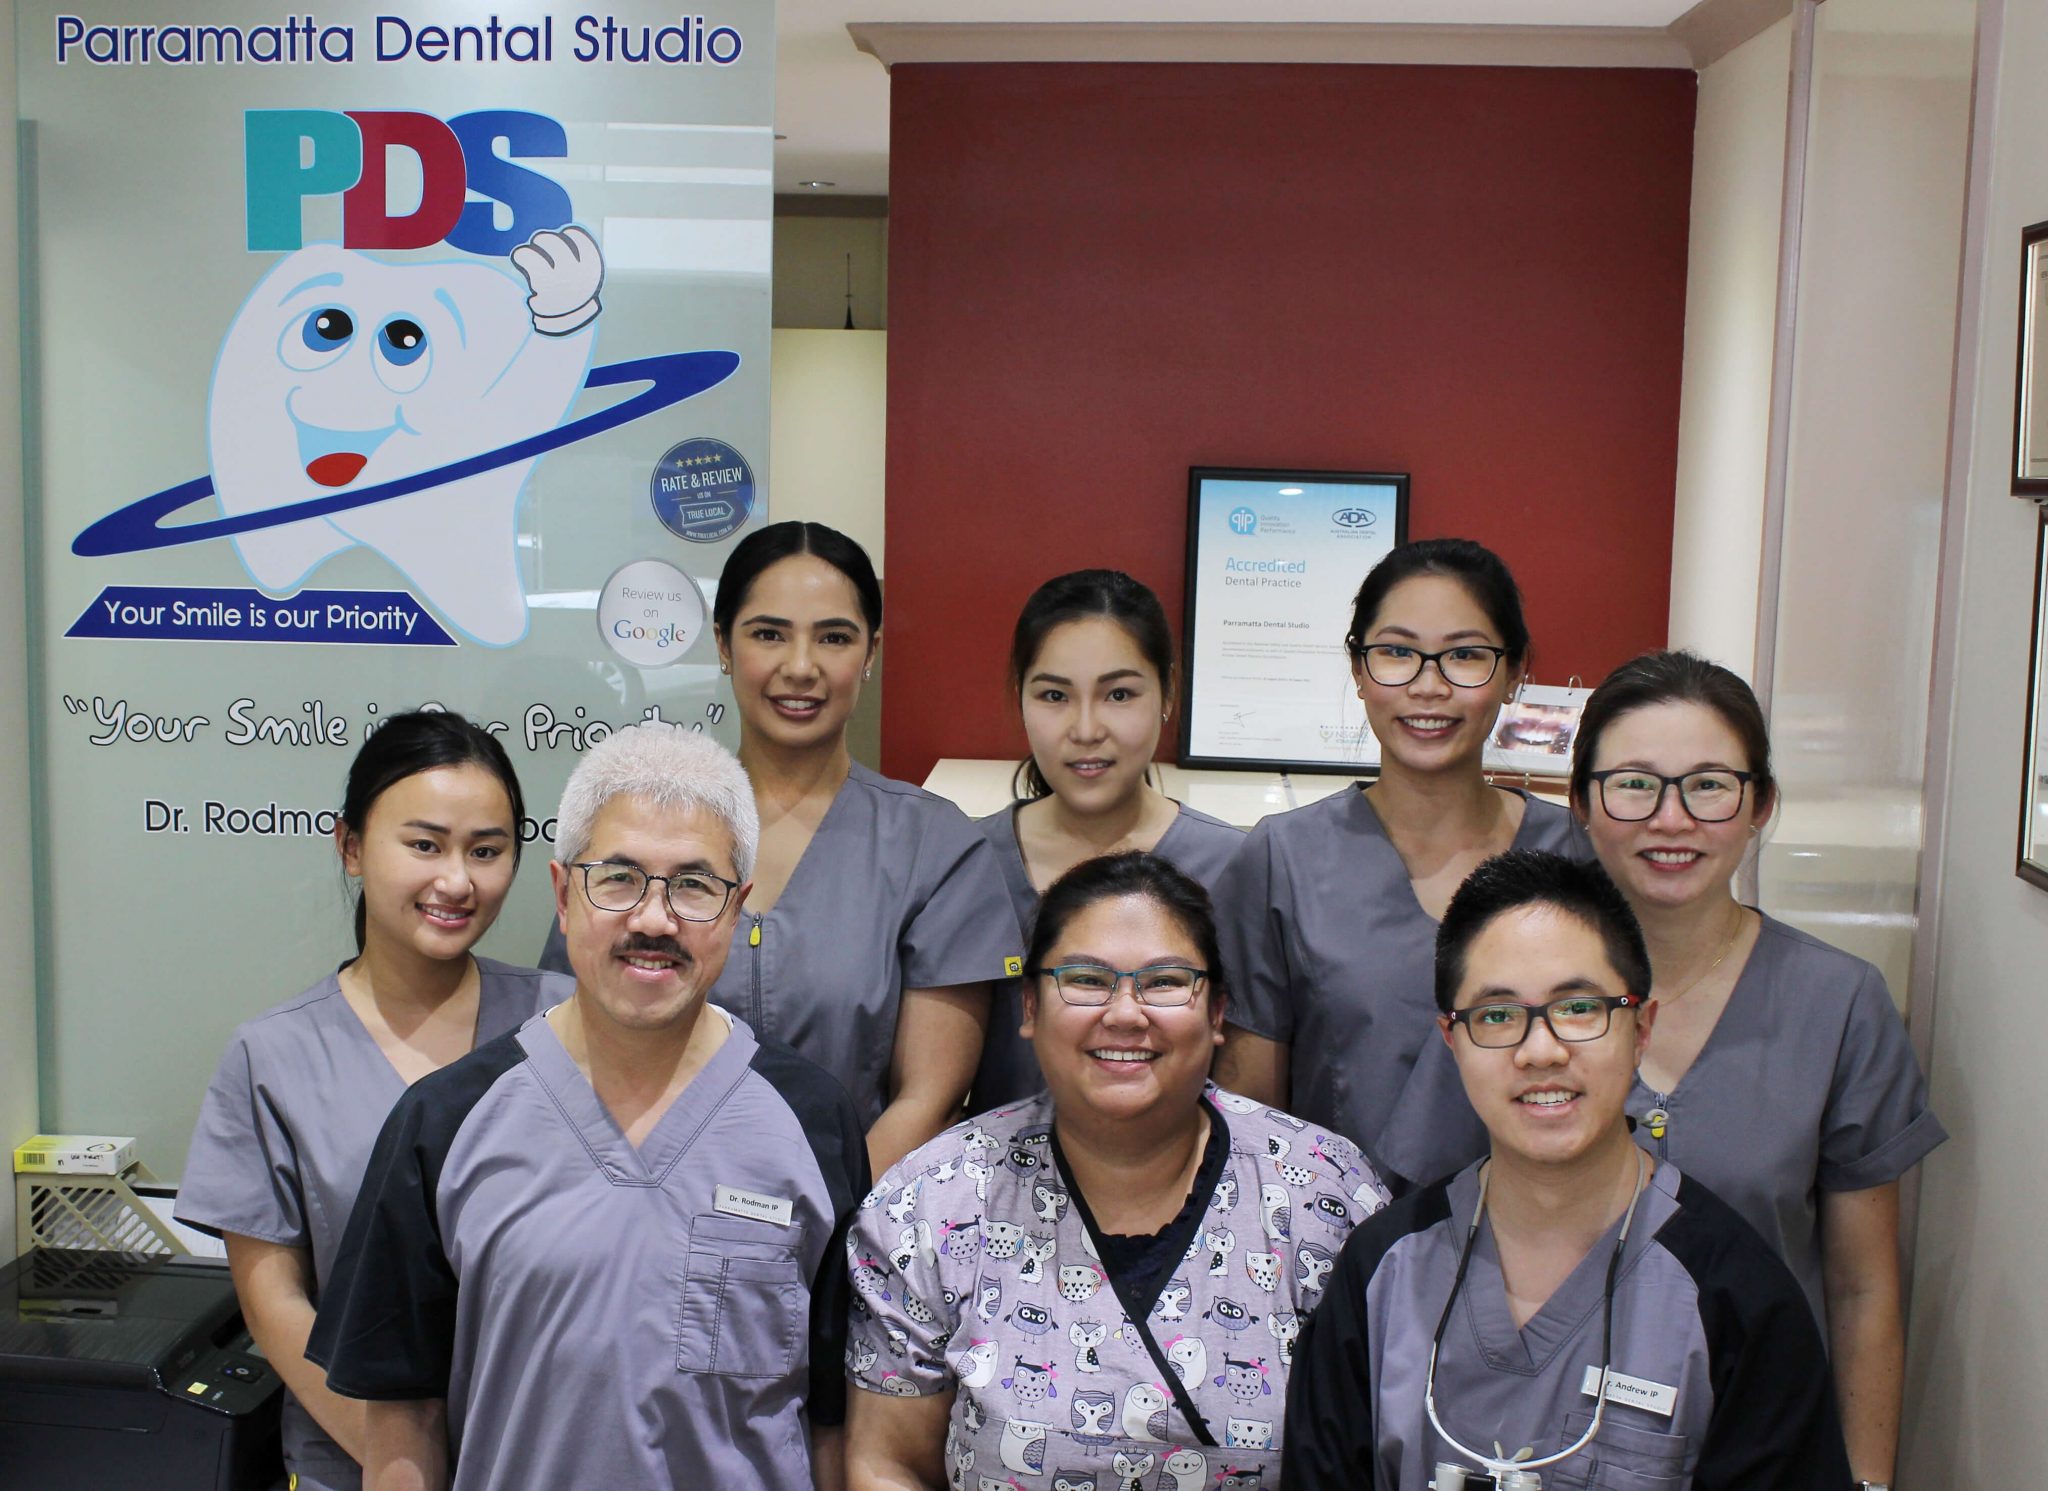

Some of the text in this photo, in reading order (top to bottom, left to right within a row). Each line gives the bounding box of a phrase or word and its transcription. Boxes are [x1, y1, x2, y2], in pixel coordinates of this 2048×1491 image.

[56, 15, 743, 64] Parramatta Dental Studio
[243, 109, 573, 256] PDS
[661, 467, 742, 492] RATE & REVIEW
[686, 506, 726, 520] TRUE LOCAL
[1339, 512, 1368, 524] ADA
[1225, 557, 1306, 574] Accredited
[1225, 576, 1302, 588] Dental Practice
[622, 587, 682, 602] Review us
[103, 600, 419, 636] Your Smile is our Priority
[643, 608, 659, 618] on
[1223, 619, 1262, 628] Parramatta
[1263, 621, 1286, 629] Dental
[613, 619, 686, 648] Google
[225, 698, 349, 747] Smile
[144, 800, 339, 836] Dr. Rodma
[741, 1197, 770, 1209] Rodman
[771, 1203, 779, 1211] IP
[1615, 1381, 1648, 1396] Andrew
